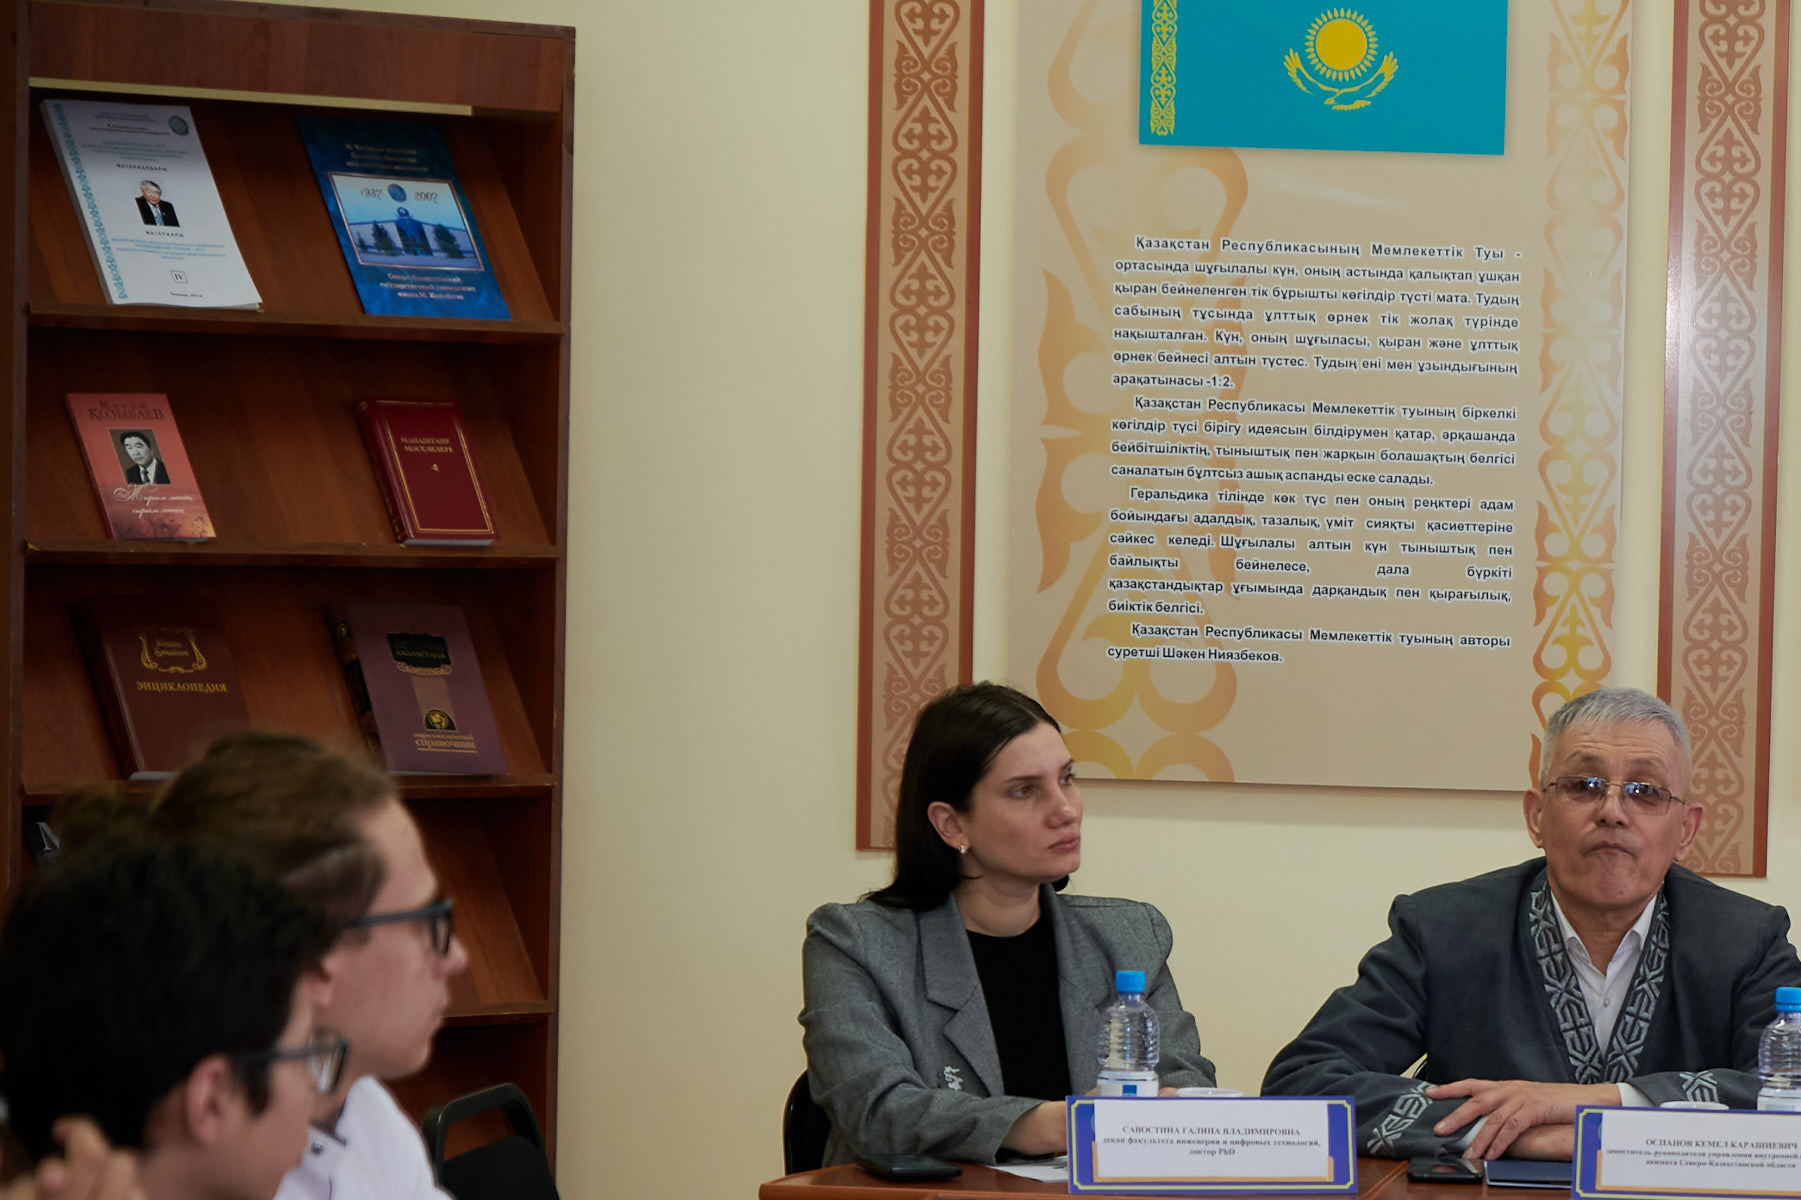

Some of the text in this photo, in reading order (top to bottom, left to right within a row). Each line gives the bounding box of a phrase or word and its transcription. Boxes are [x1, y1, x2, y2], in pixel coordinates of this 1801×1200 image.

[1114, 261, 1519, 284] ортасында шұғылалы күн, оның астында қалықтап ұшқан
[1114, 282, 1520, 307] қыран бейнеленген тік бұрышты көгілдір түсті мата. Тудың
[1114, 329, 1519, 352] нақышталған. Күн, оның шұғыласы, қыран және ұлттық
[1111, 440, 1515, 465] бейбітшіліктің, тыныштық пен жарқын болашақтың белгісі
[1109, 534, 1512, 556] сәйкес келеді. Шұғылалы алтын күн тыныштық пен
[1131, 623, 1510, 648] Қазақстан Республикасы Мемлекеттік туының авторы
[1107, 646, 1282, 662] суретші Шәкен Ниязбеков.
[136, 680, 228, 694] ЭНЦИКЛОПЕДИЯ
[1121, 1126, 1301, 1137] САВОСТИНА ГАЛИНА ВЛАДИМИРОВНА
[1218, 1147, 1236, 1156] PhD
[1645, 1138, 1693, 1148] ОСПАНОВ
[1694, 1139, 1729, 1148] КЕМЕЛ
